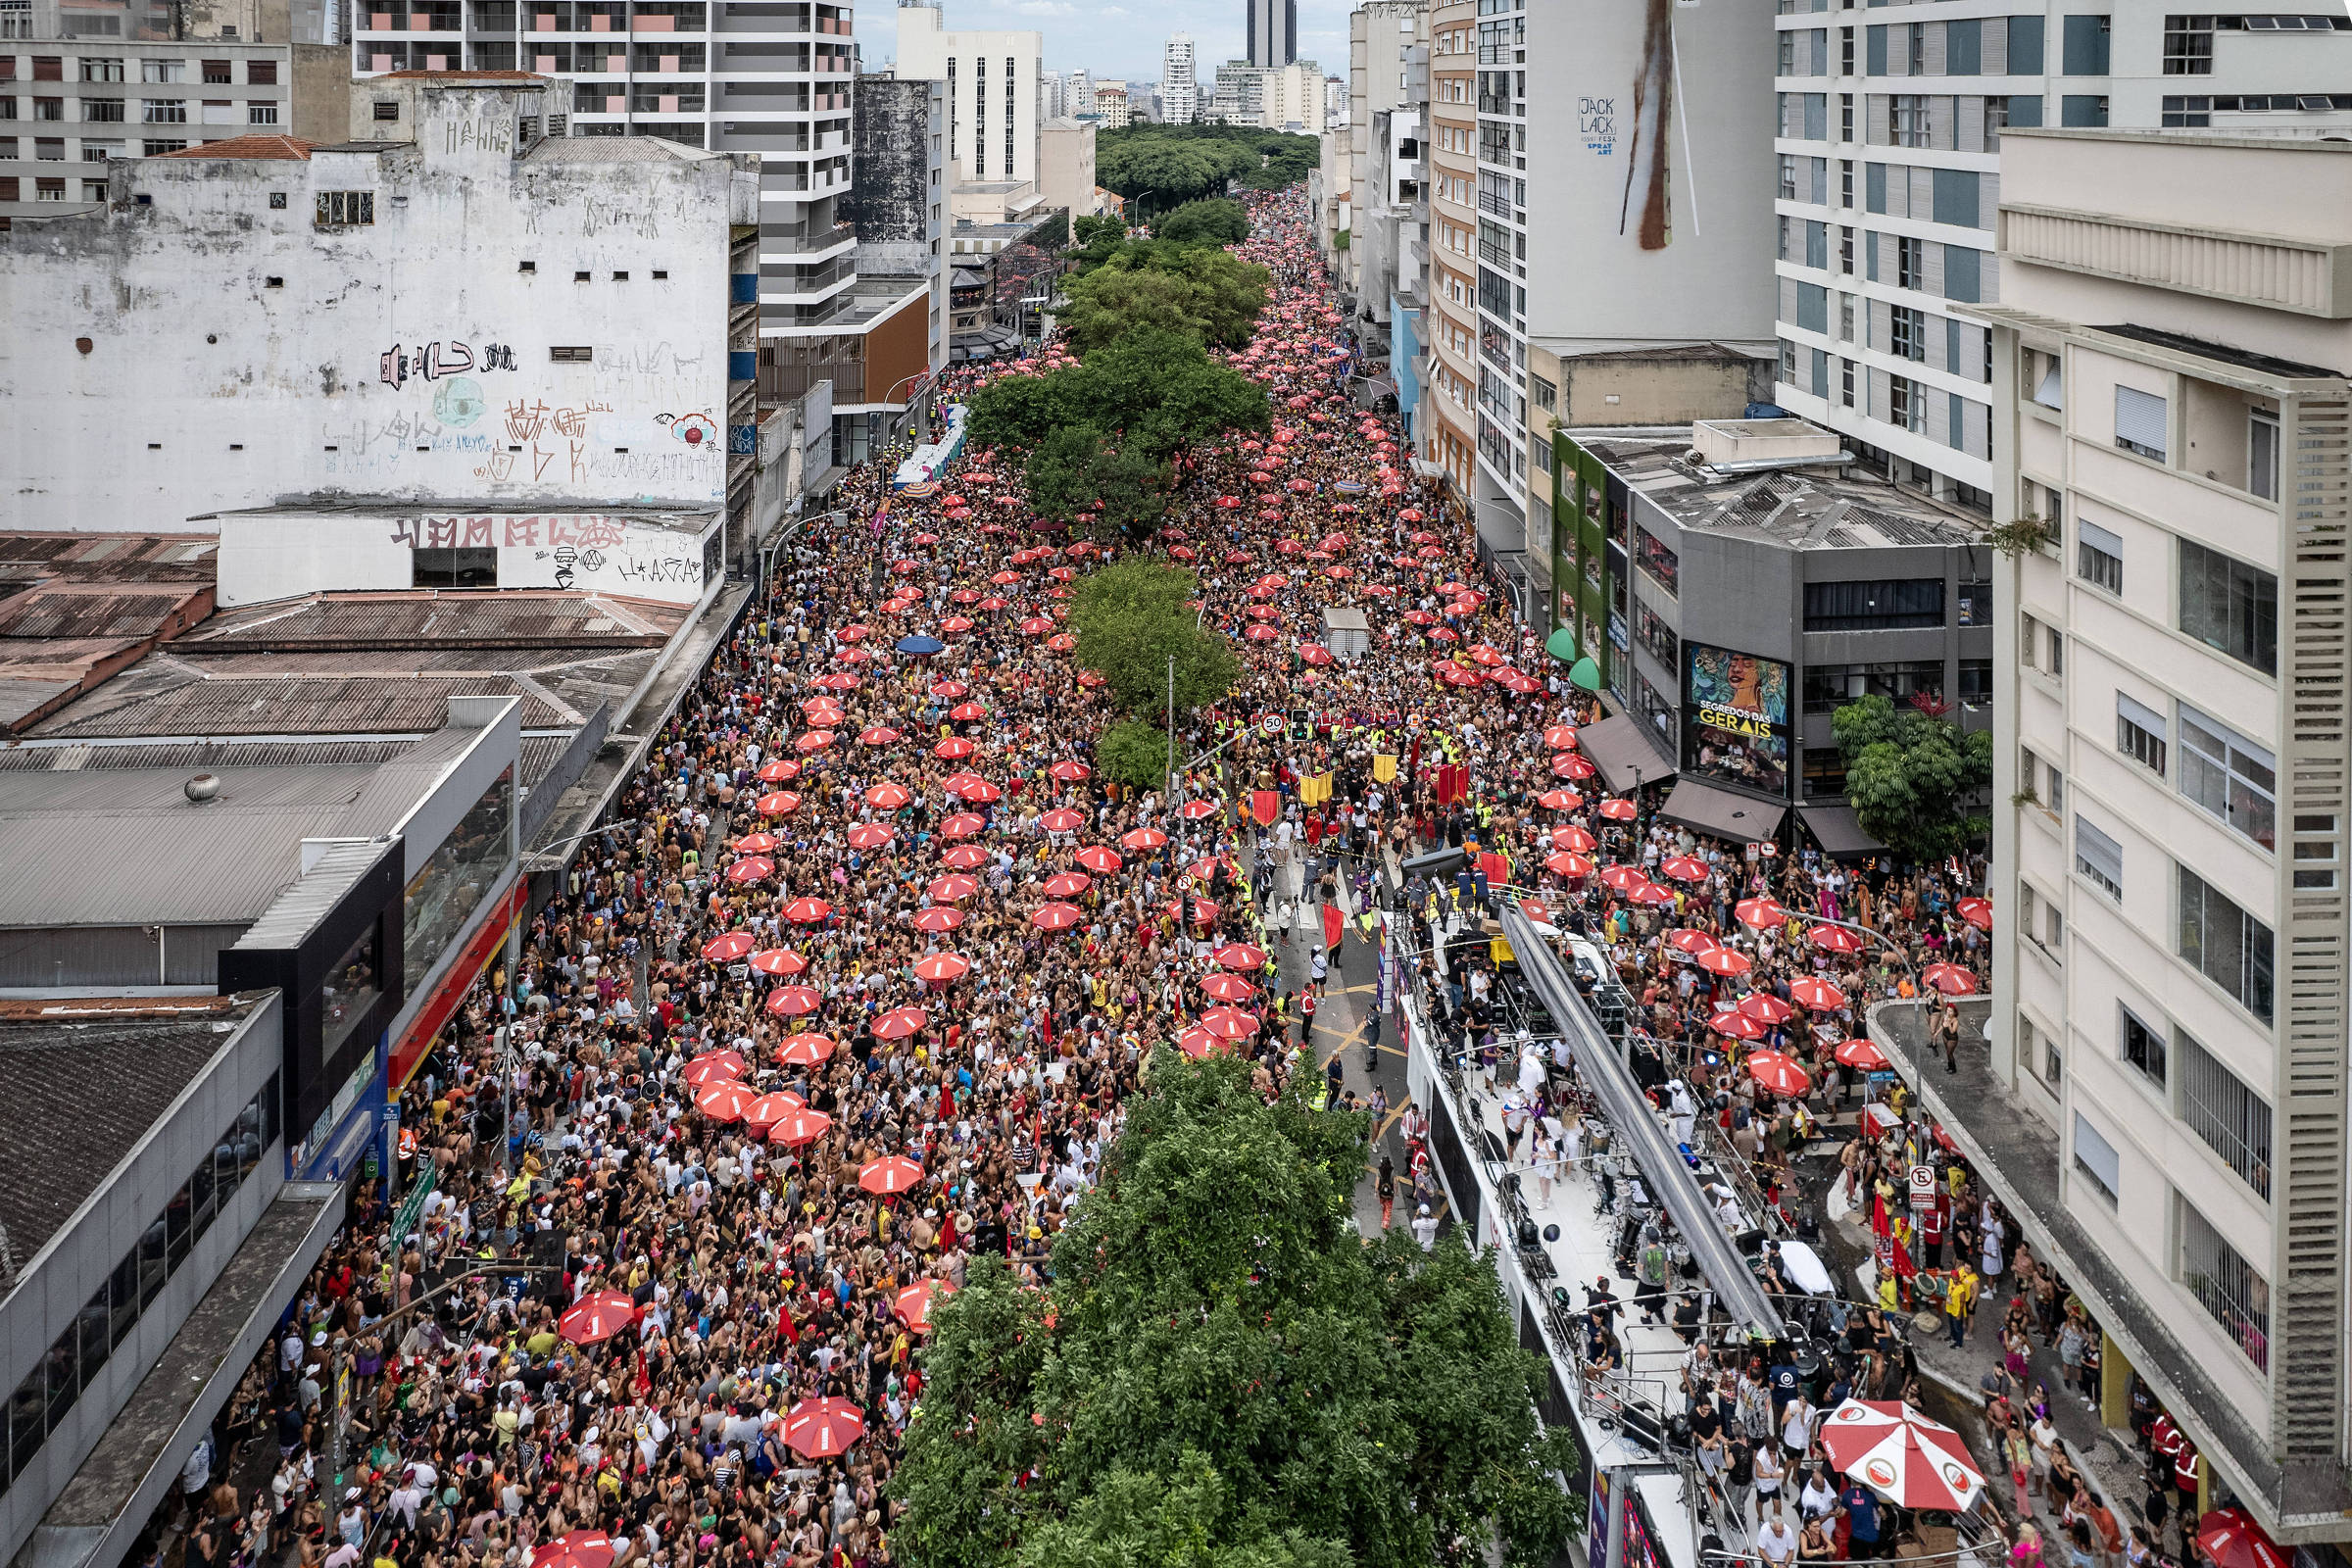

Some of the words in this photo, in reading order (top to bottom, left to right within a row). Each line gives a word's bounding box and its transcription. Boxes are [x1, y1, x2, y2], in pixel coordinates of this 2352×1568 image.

[1581, 98, 1614, 115] JACK
[1581, 117, 1614, 133] LACK
[1699, 700, 1750, 719] SEGREDOS
[1751, 712, 1771, 724] DAS
[1266, 717, 1281, 728] 50
